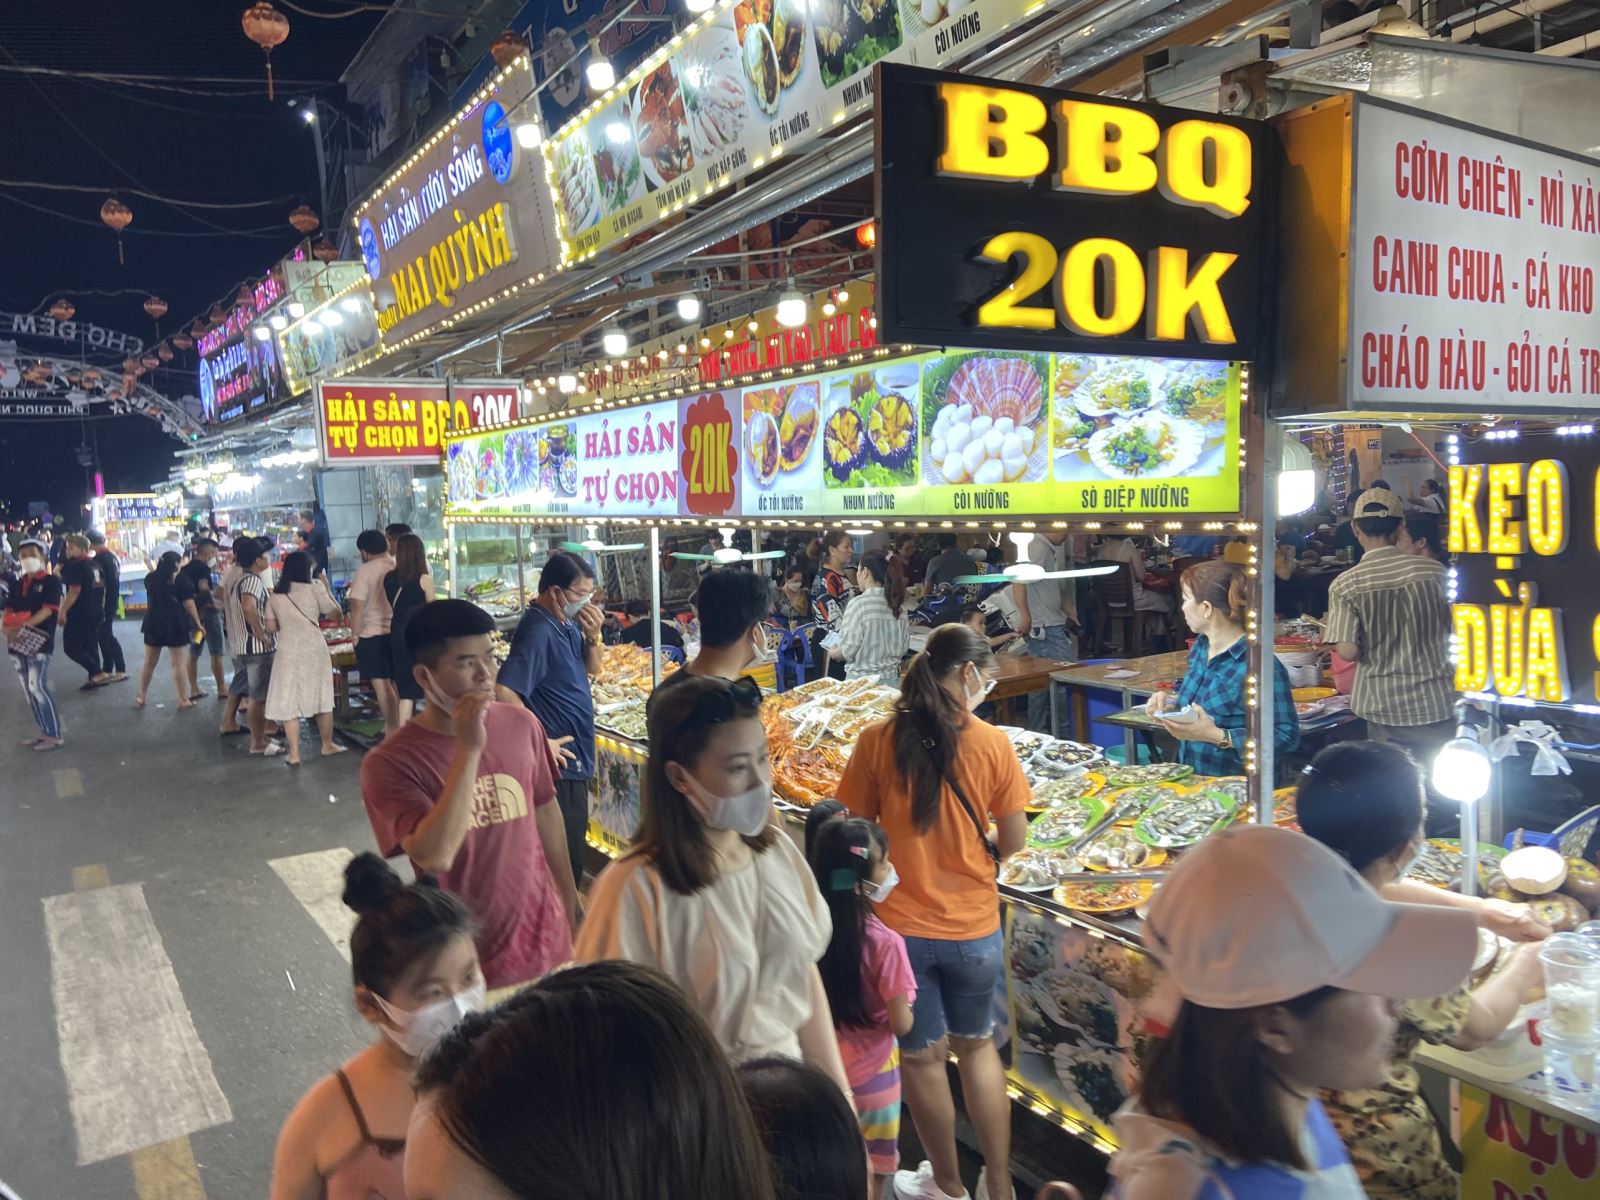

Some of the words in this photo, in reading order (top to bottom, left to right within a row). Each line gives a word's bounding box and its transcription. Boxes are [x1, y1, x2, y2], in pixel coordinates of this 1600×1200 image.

[935, 28, 951, 55] CÒI
[937, 81, 1252, 218] BBQ
[1395, 140, 1449, 205] CƠM
[1458, 155, 1521, 219] CHIÊN
[1540, 169, 1564, 228] MÌ
[1571, 177, 1600, 234] XÀ
[391, 256, 433, 317] MAI
[428, 203, 513, 308] QUỲNH
[977, 231, 1240, 345] 20K
[1372, 235, 1438, 297] CANH
[1447, 246, 1505, 304] CHUA
[1525, 251, 1551, 310] CÁ
[1558, 263, 1593, 315] KHO
[1361, 324, 1430, 390] CHÁO
[1439, 328, 1486, 392] HÀU
[1507, 330, 1541, 393] GỎI
[1547, 338, 1572, 394] CÁ
[327, 392, 367, 422] HẢI
[373, 392, 416, 422] SẢN
[585, 419, 621, 460] HẢI
[627, 411, 676, 455] SẢN
[329, 423, 359, 454] TỰ
[364, 425, 419, 453] CHỌN
[690, 423, 731, 495] 20K
[583, 468, 611, 508] TỰ
[615, 470, 679, 508] CHỌN
[758, 492, 768, 511] ỐC
[843, 495, 866, 511] NHUM
[954, 489, 971, 510] CÒI
[974, 488, 1009, 510] NƯỚNG
[1081, 485, 1098, 509] SÒ
[1104, 485, 1136, 512] ĐIỆP
[1140, 484, 1190, 509] NƯỚNG
[1448, 459, 1563, 569] KẸO
[1453, 579, 1564, 703] DỪA
